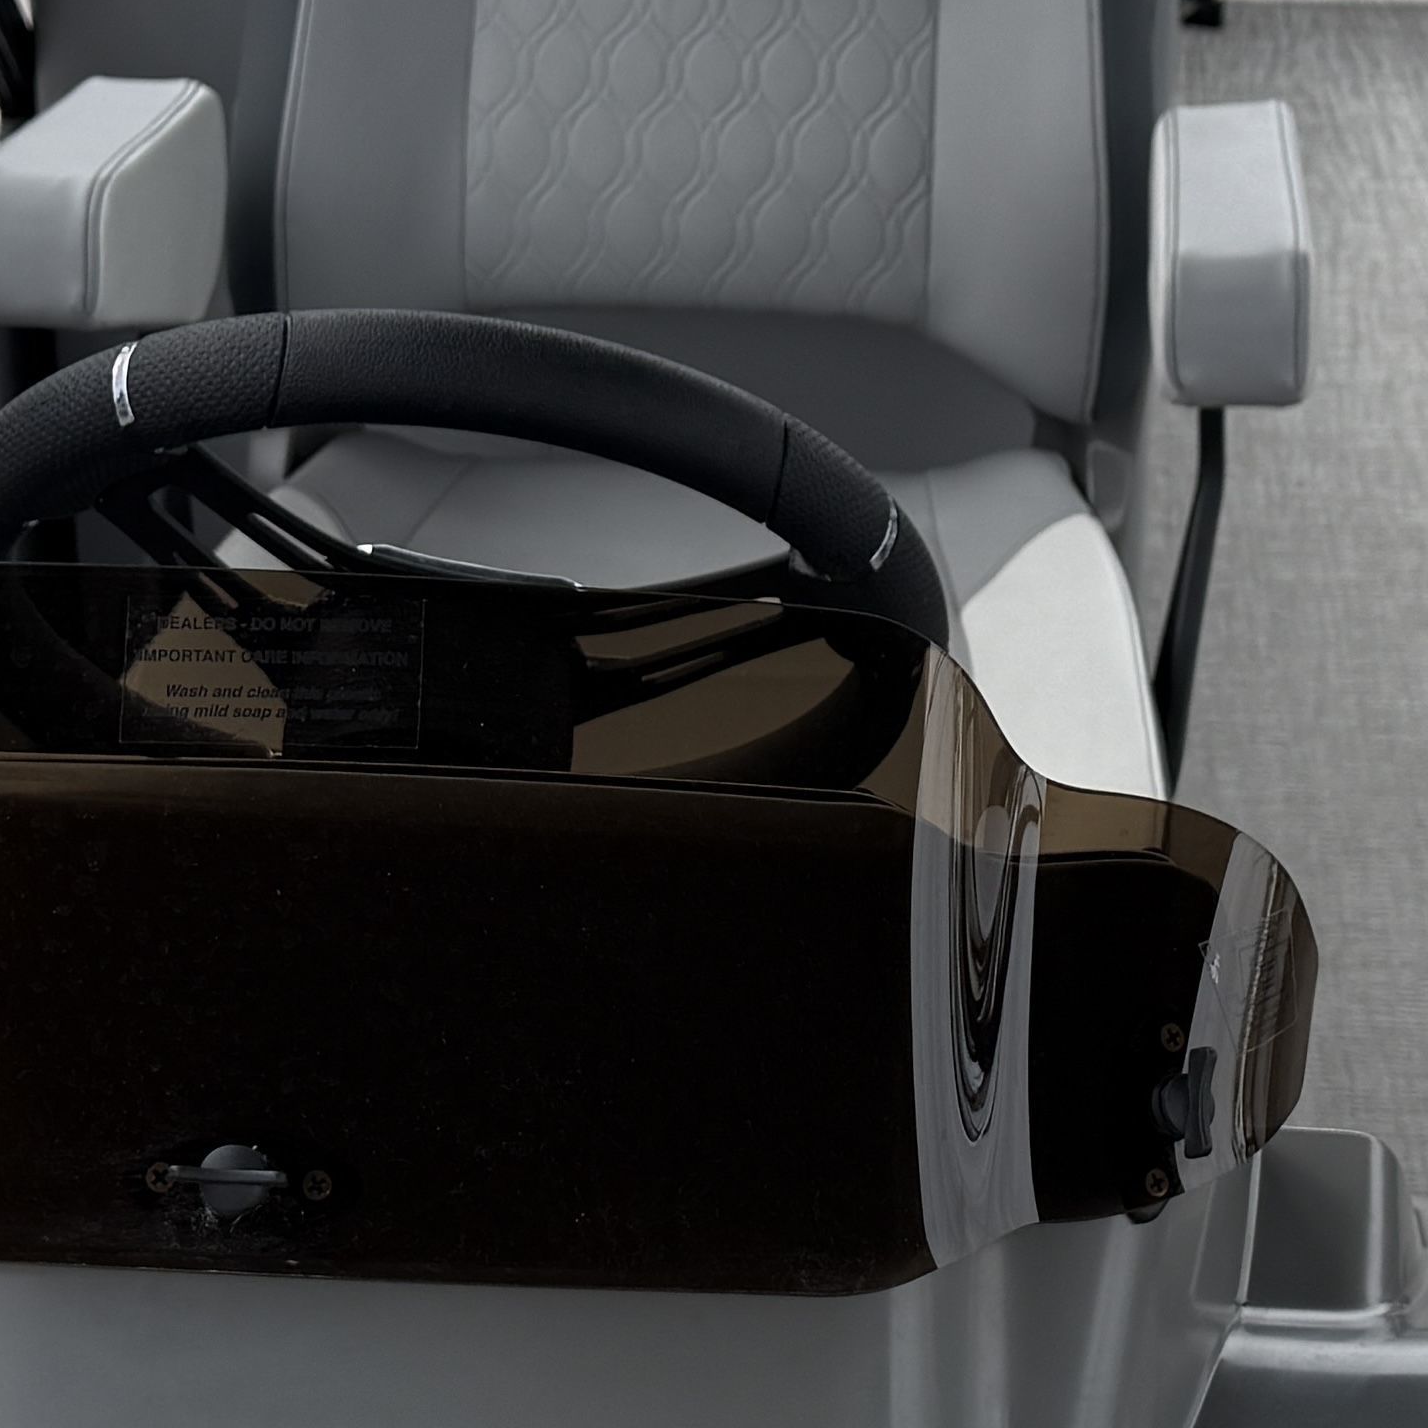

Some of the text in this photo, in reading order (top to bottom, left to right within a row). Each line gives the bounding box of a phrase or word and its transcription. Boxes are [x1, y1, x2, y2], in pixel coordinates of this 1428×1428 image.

[250, 617, 276, 632] DO
[280, 617, 316, 633] NOT
[139, 649, 237, 663] IMPORTANT
[166, 684, 209, 698] Wash
[212, 685, 243, 698] and
[194, 704, 230, 718] mild
[232, 707, 272, 721] soap
